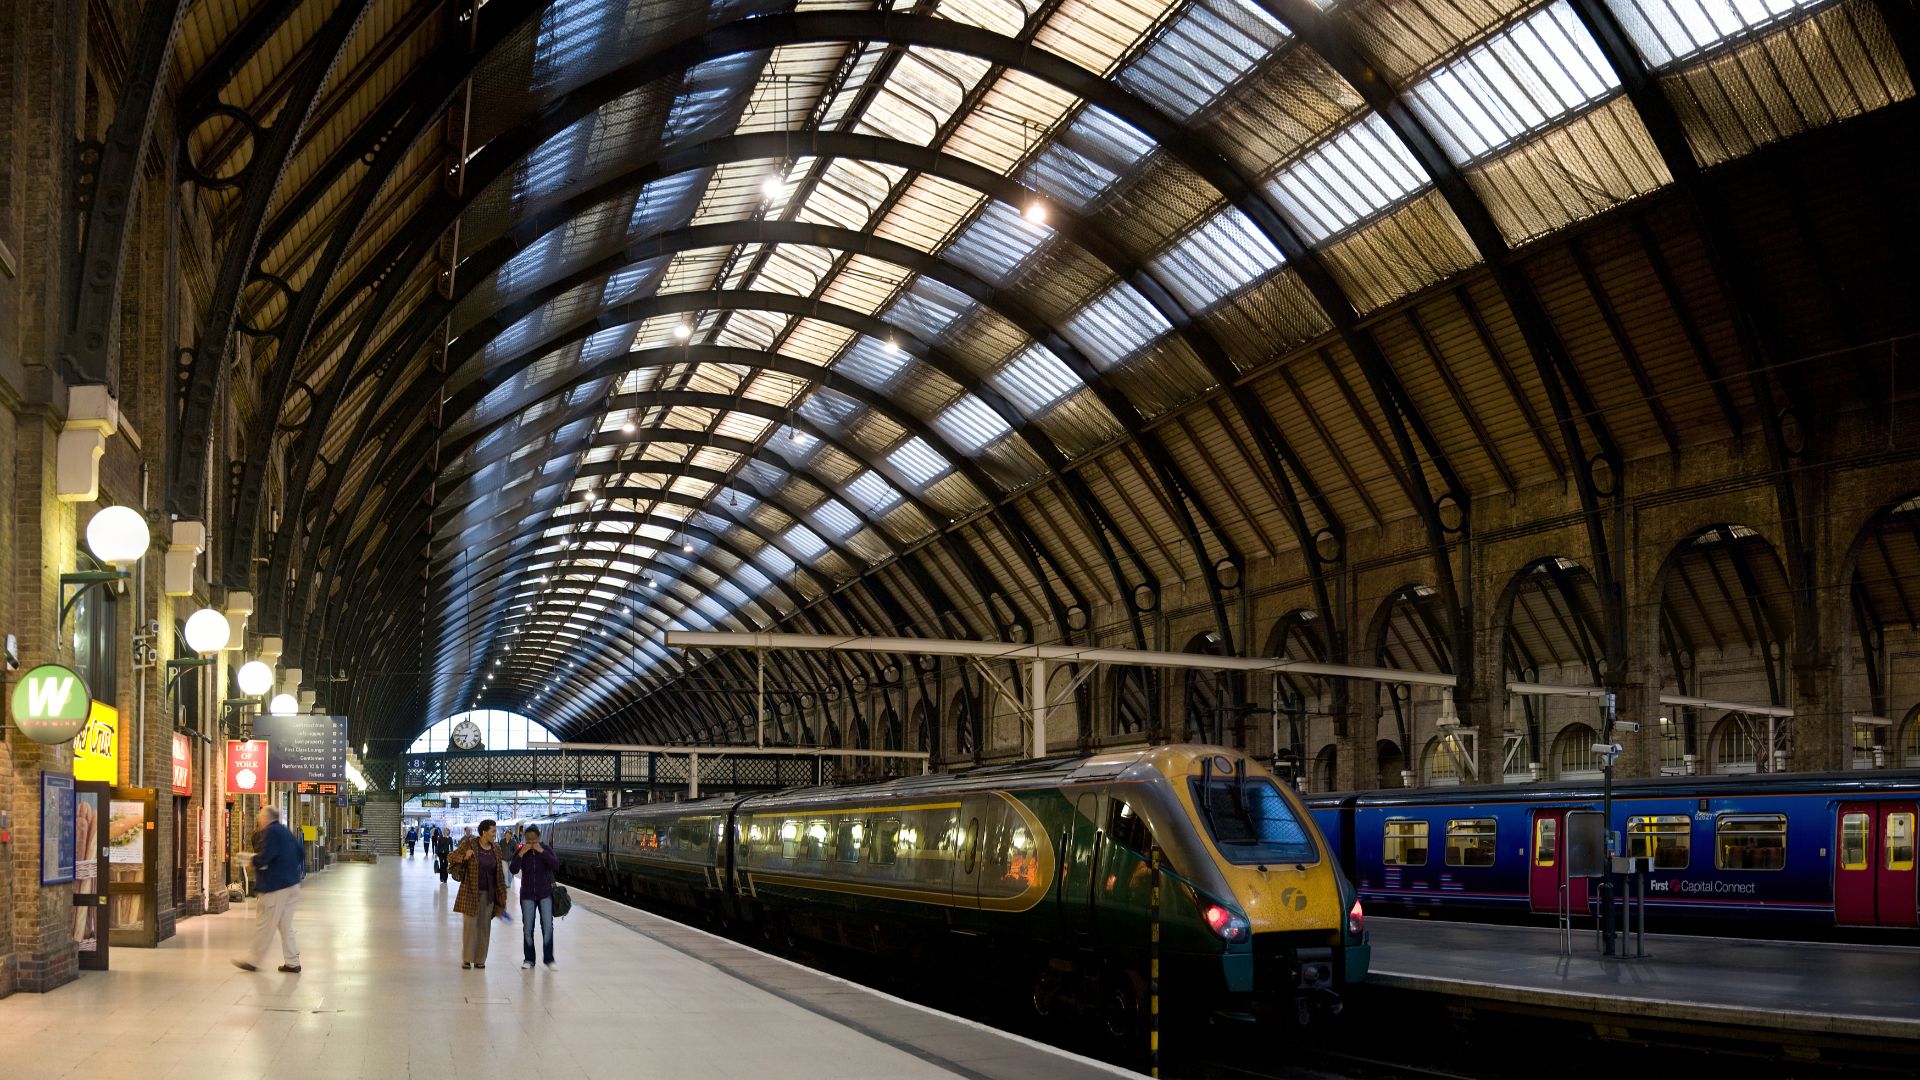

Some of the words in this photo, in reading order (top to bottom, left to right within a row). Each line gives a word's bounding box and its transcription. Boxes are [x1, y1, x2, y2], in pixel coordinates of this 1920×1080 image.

[28, 677, 74, 717] W
[413, 759, 420, 768] 8
[1650, 880, 1669, 891] First
[1681, 880, 1713, 893] Capital
[1714, 881, 1755, 893] Connect
